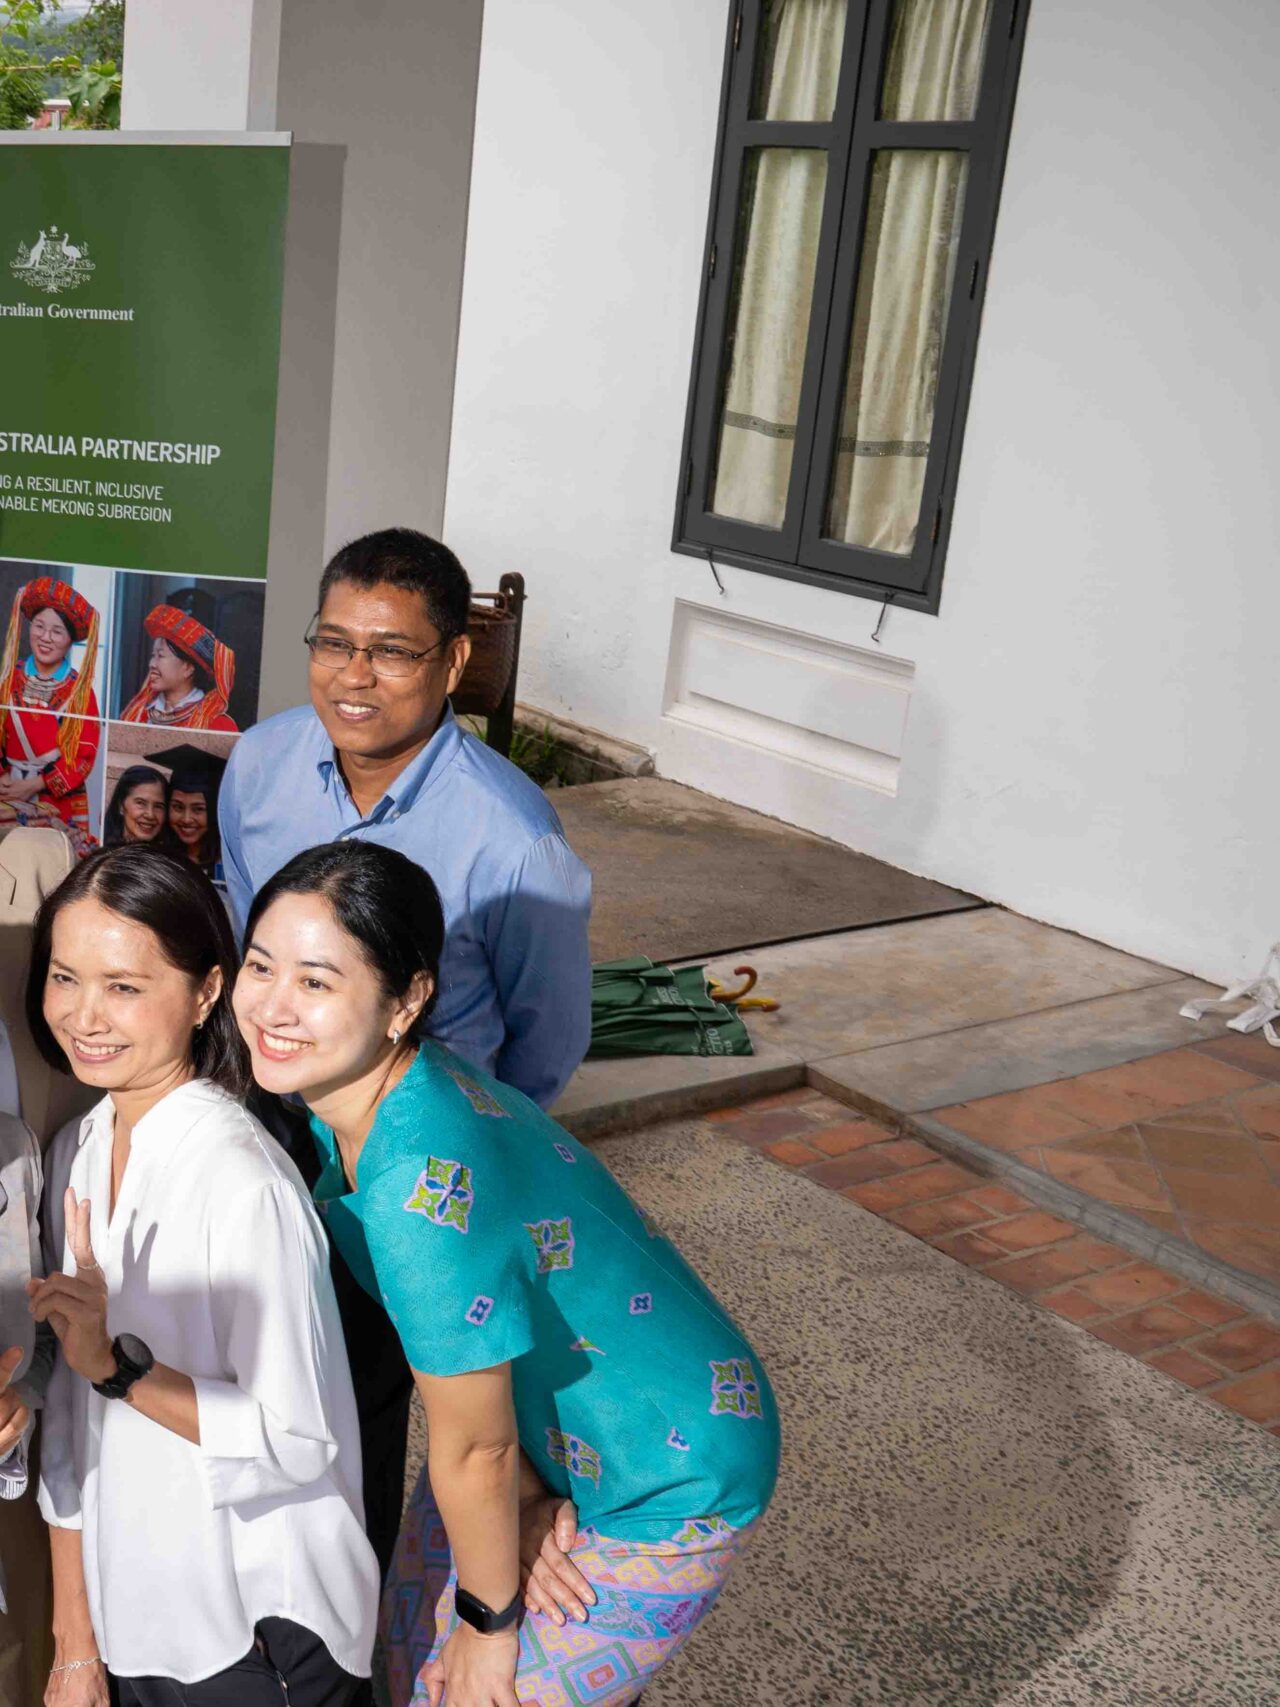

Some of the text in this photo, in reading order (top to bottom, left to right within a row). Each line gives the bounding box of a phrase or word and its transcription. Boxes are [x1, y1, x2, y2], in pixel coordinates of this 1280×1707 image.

[47, 303, 135, 321] Government
[81, 436, 222, 466] PARTNERSHIP
[14, 475, 24, 490] A
[27, 476, 92, 496] RESILIENT,
[95, 481, 164, 501] INCLUSIVE
[41, 498, 95, 517] MEKONG
[97, 502, 172, 523] SUBREGION
